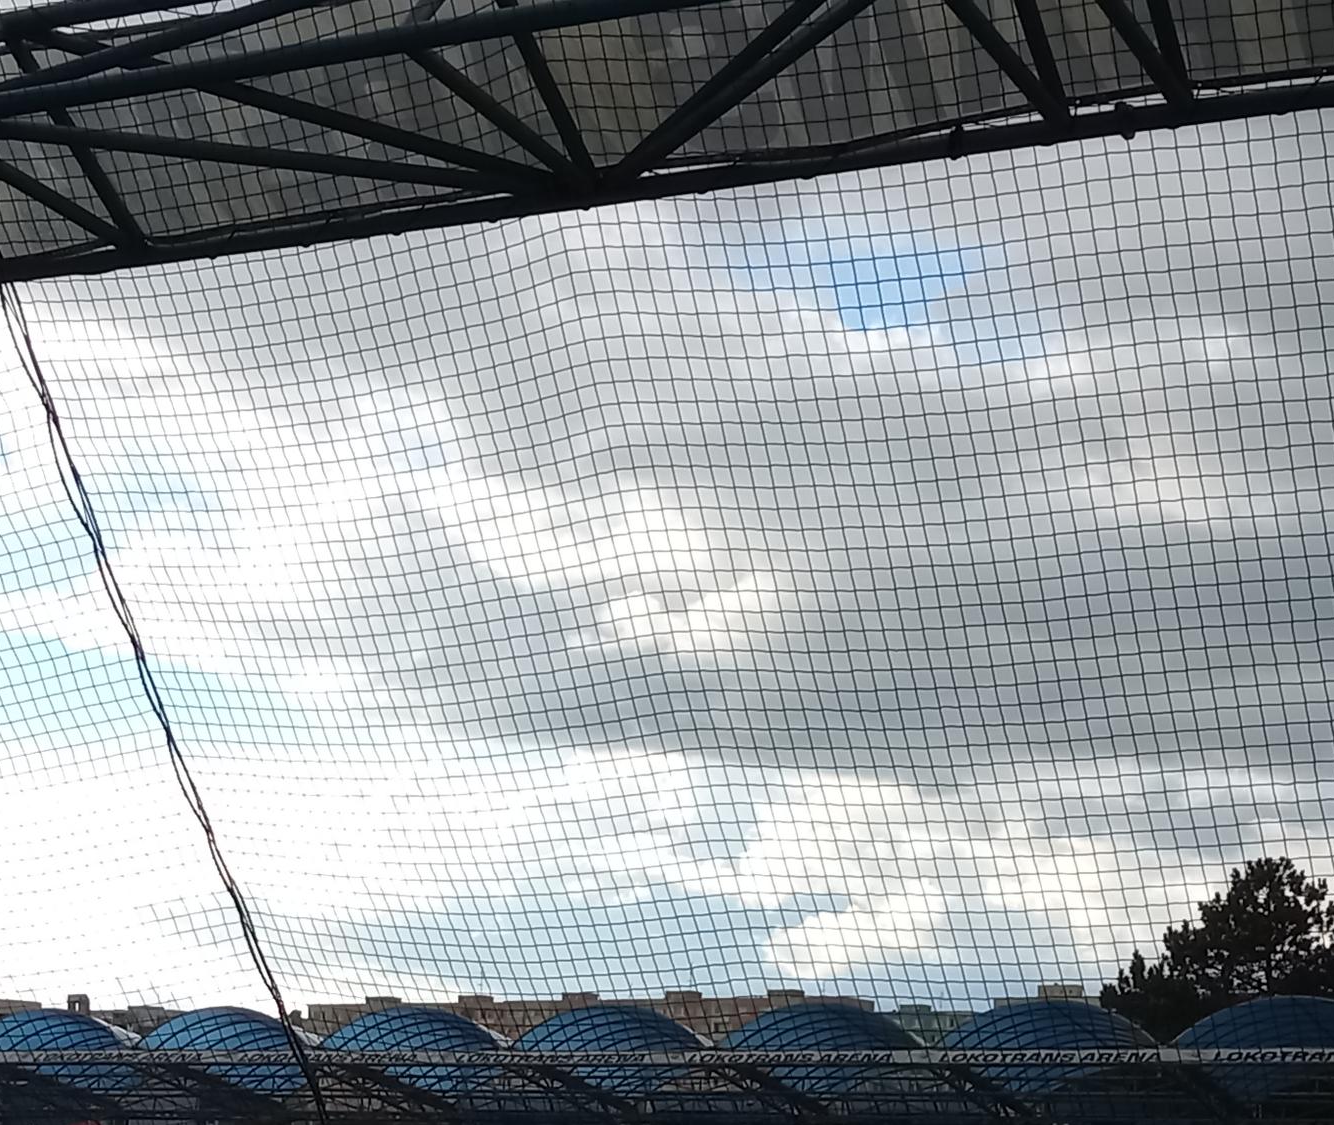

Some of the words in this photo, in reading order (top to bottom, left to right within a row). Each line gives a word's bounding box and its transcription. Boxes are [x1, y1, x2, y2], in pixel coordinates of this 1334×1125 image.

[456, 1053, 569, 1063] LOKOTRANS
[577, 1053, 647, 1063] ARENA
[687, 1052, 814, 1063] LOKOTRANS
[819, 1052, 892, 1063] ARENA
[938, 1052, 1075, 1063] LOKOTRANS
[1079, 1052, 1161, 1063] ARENA
